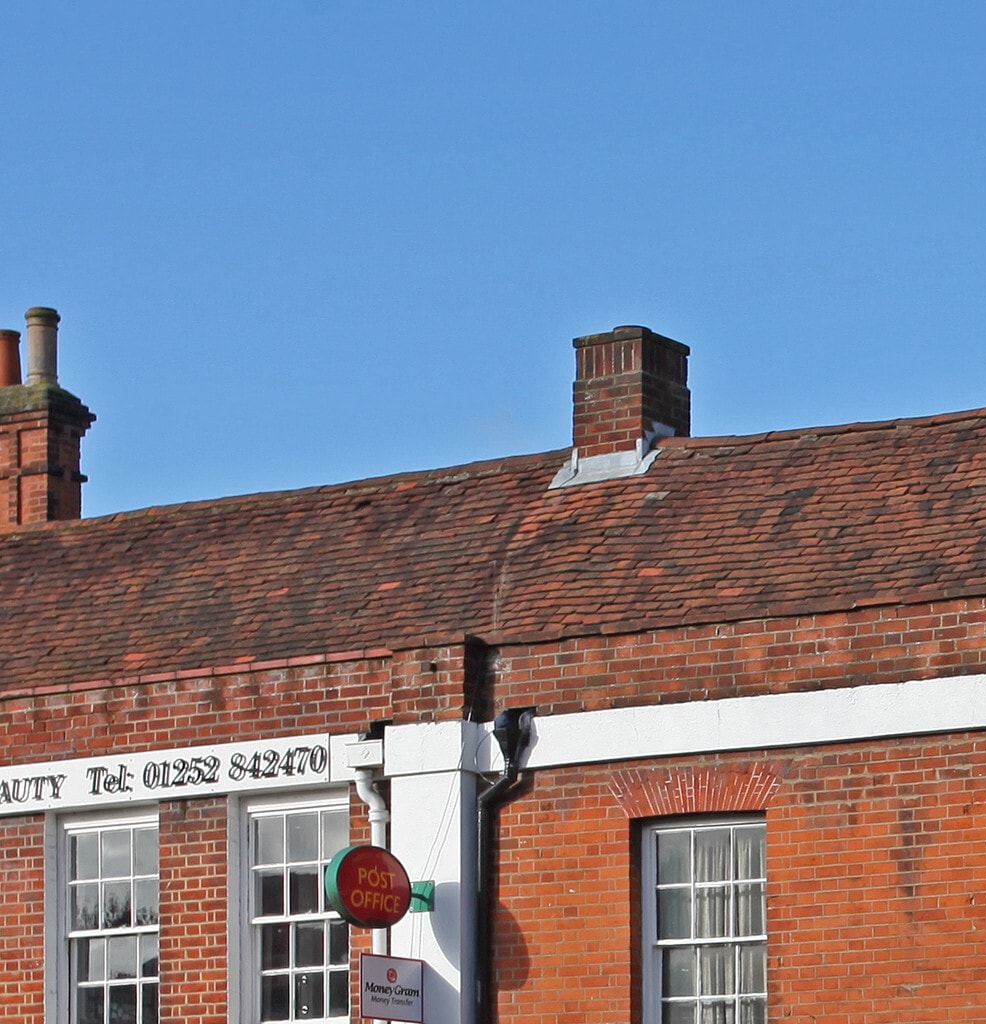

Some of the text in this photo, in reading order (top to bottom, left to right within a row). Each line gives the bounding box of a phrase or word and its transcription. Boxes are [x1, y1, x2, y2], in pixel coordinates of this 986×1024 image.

[86, 764, 134, 795] Tel:
[142, 755, 221, 789] 01252
[228, 745, 327, 781] 842470
[358, 867, 396, 890] POST
[351, 889, 401, 913] OFFICE
[364, 982, 420, 998] MoneyGram
[370, 995, 414, 1007] Money Transfer
